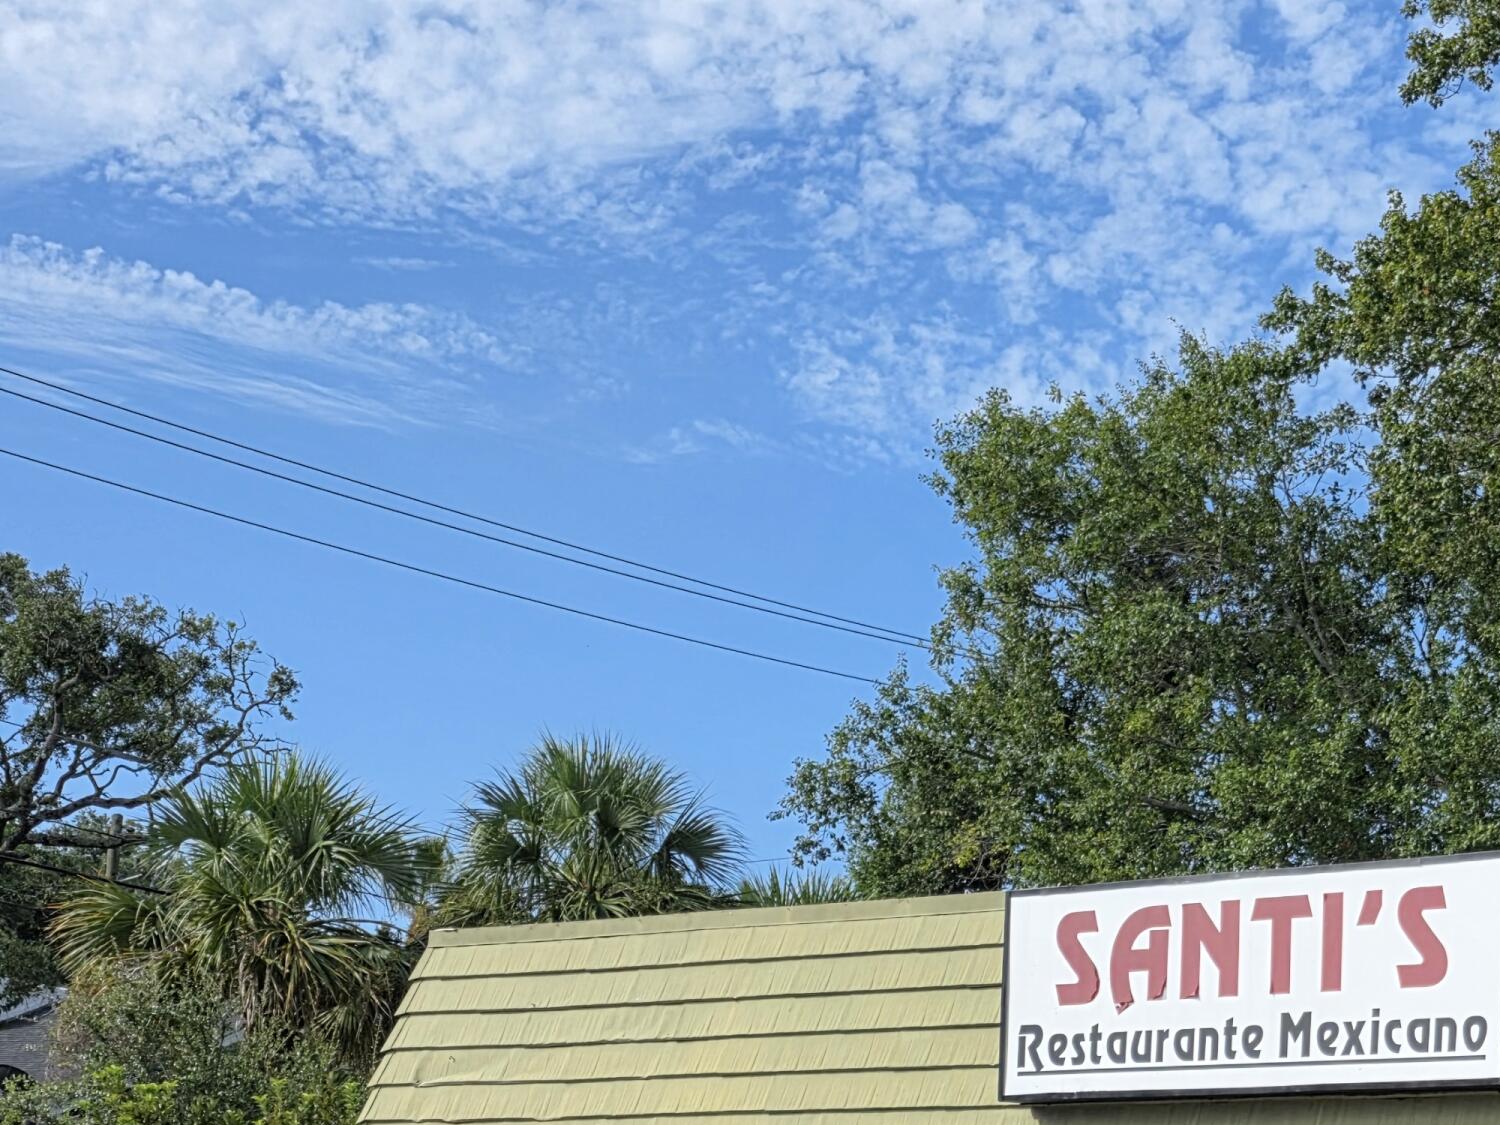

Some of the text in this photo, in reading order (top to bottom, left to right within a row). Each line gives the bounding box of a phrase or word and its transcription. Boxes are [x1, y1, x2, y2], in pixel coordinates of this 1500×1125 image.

[1055, 885, 1449, 1014] SANTI'S
[1017, 1008, 1488, 1072] Restaurante Mexicano
